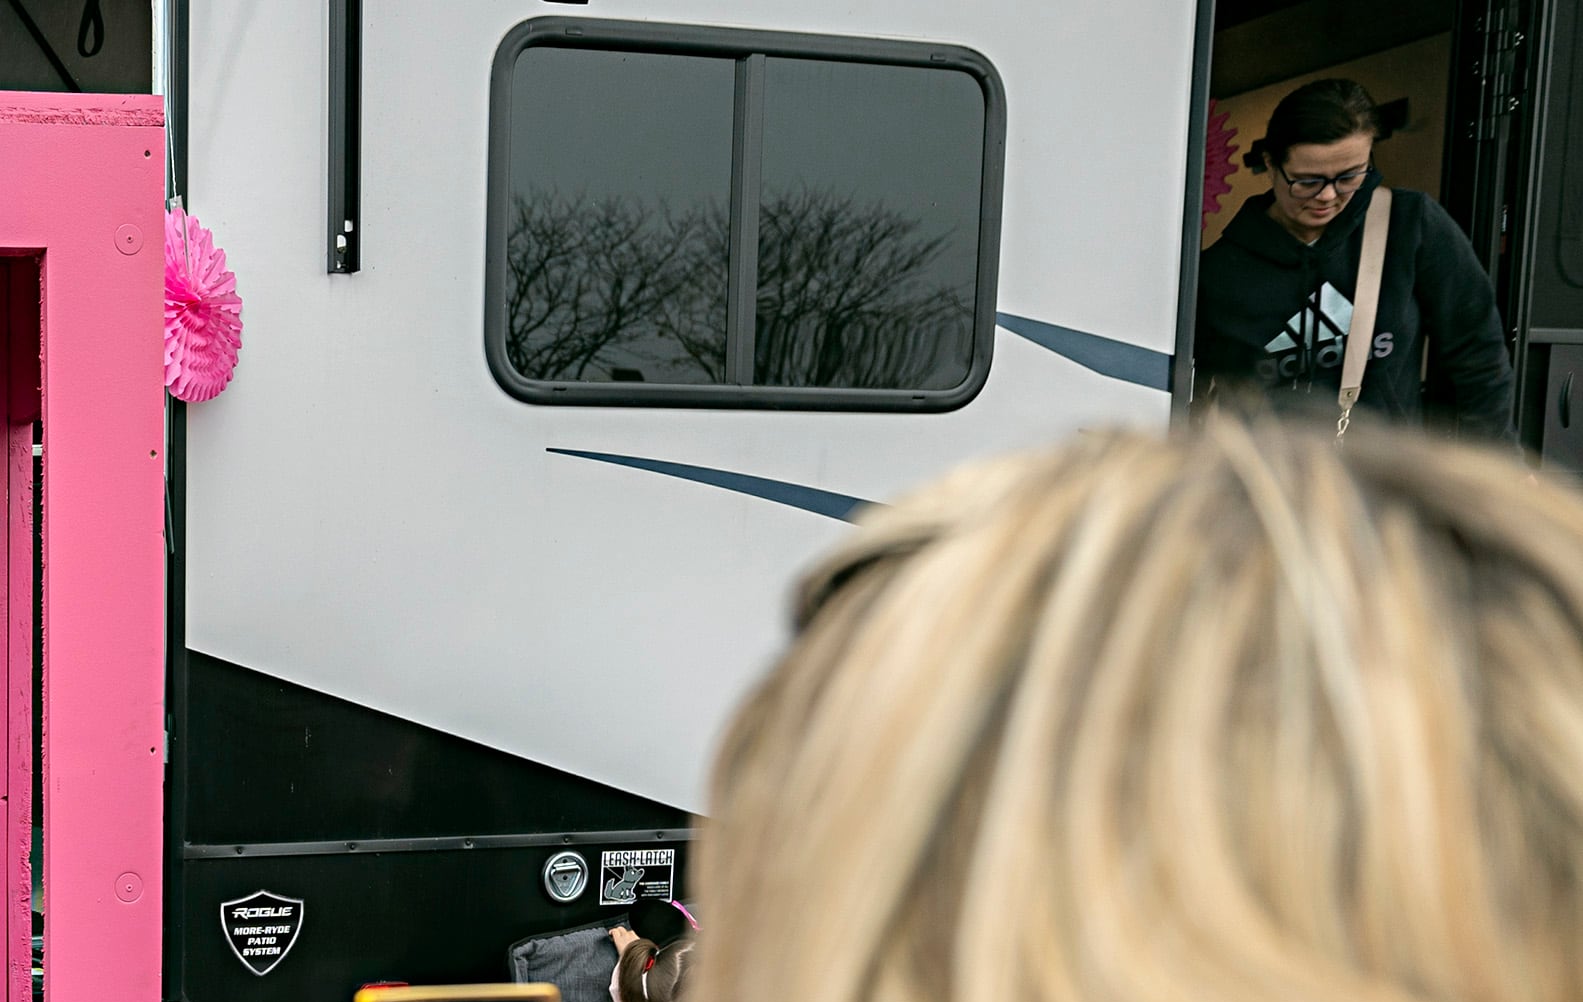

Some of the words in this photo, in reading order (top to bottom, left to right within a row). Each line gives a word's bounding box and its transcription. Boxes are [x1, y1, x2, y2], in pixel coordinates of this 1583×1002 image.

[232, 907, 293, 919] ROGUE
[233, 926, 291, 936] MORE-RYDE
[247, 937, 277, 946] PATIO
[242, 947, 281, 956] SYSTEM
